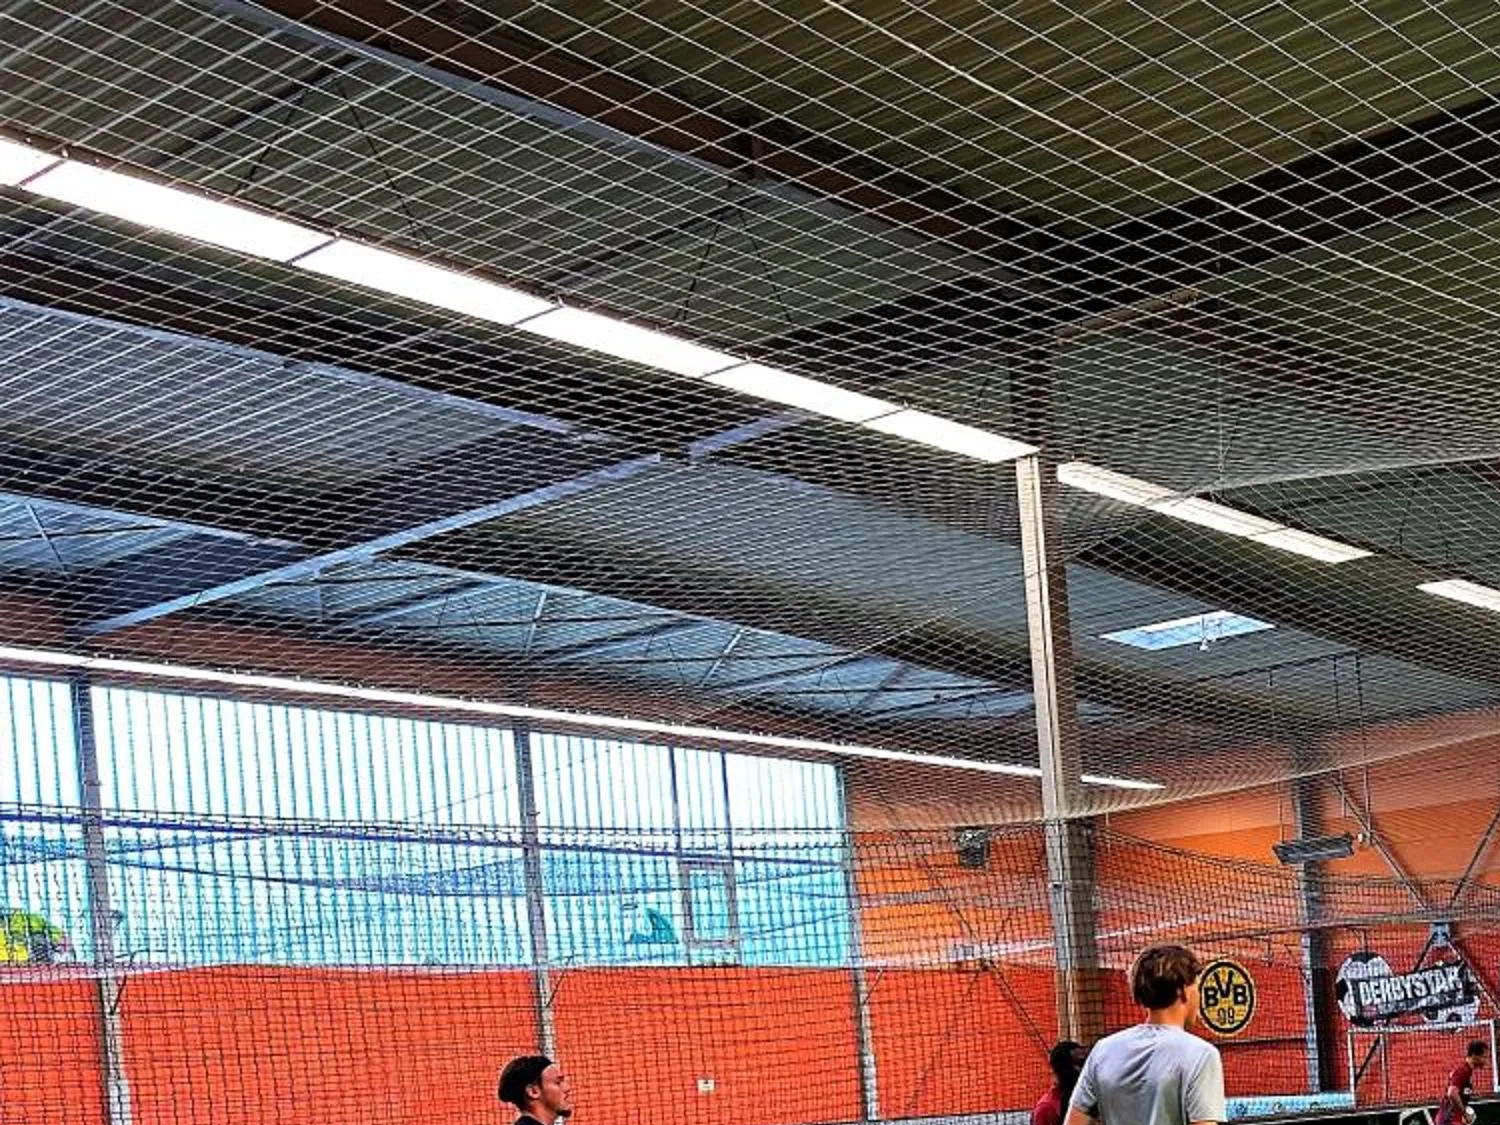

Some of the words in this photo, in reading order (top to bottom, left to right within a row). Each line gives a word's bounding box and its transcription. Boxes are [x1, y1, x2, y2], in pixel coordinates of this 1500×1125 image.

[1204, 967, 1248, 1006] BVB
[1359, 965, 1464, 1003] DERBYSTAR
[1217, 1008, 1236, 1026] 09
